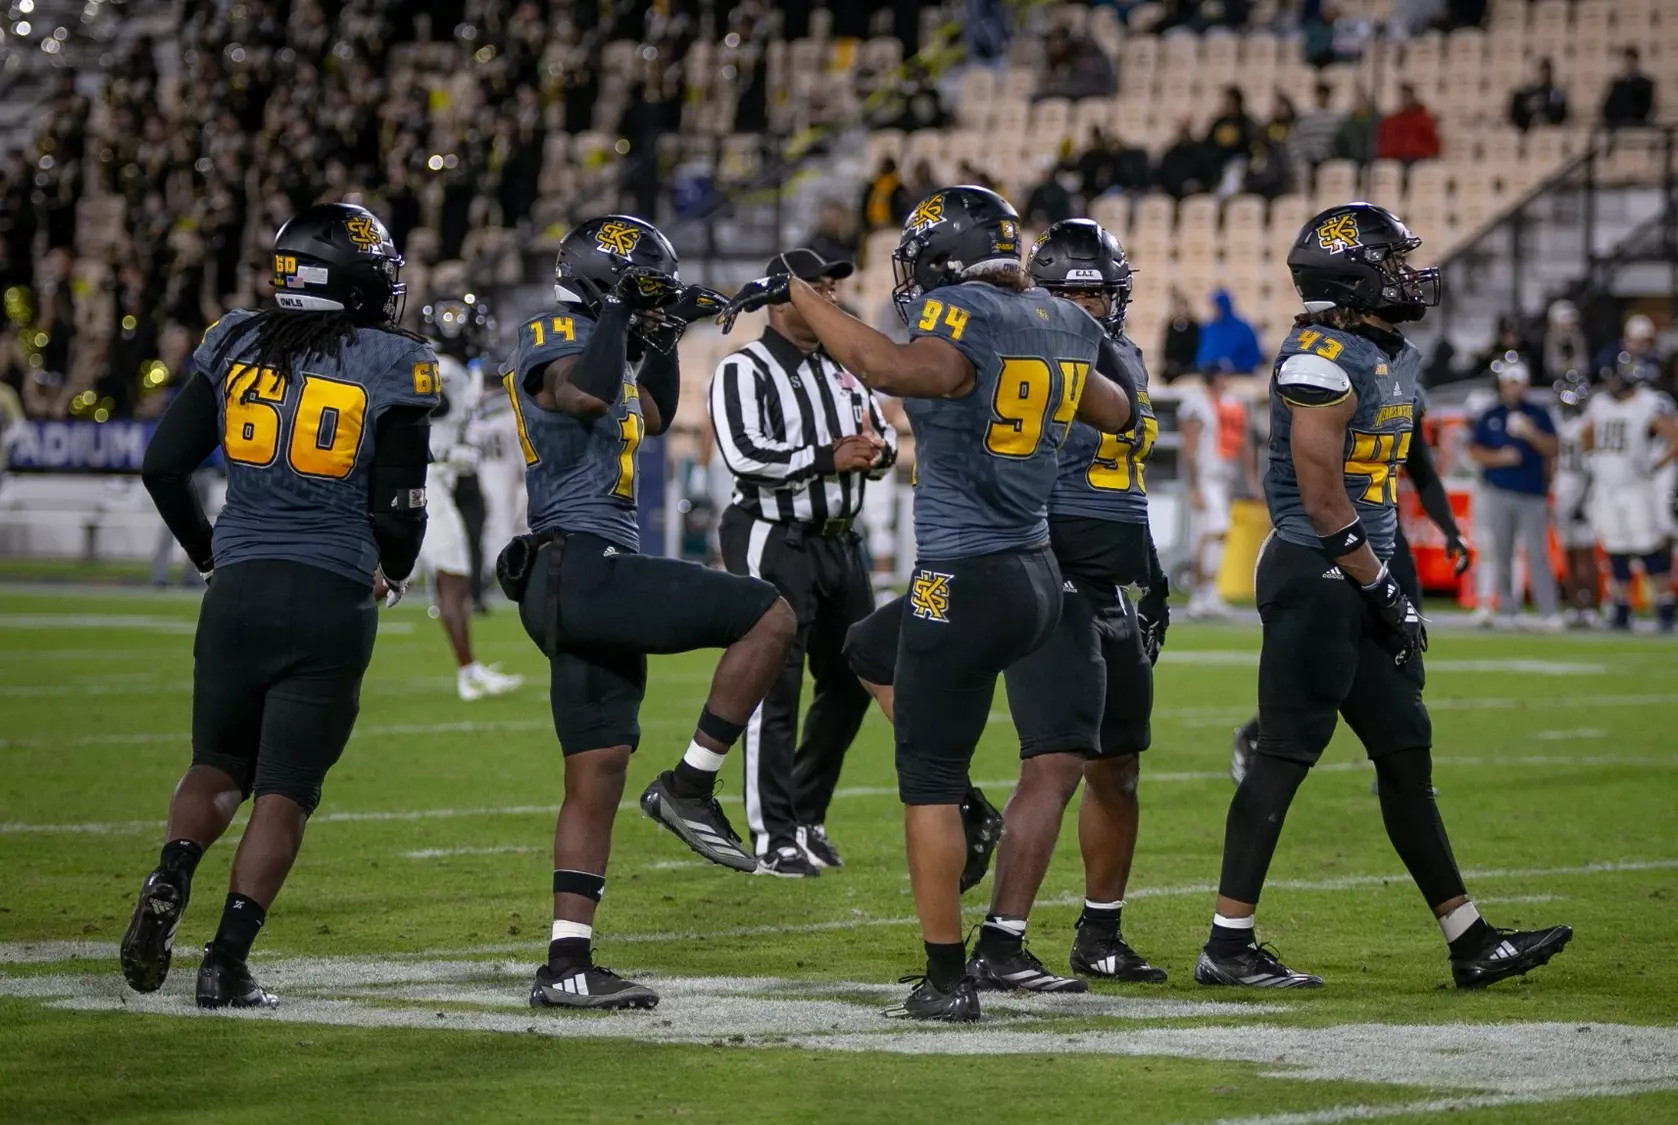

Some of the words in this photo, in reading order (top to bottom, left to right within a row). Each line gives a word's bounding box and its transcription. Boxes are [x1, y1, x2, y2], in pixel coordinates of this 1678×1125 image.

[275, 255, 296, 273] 60
[280, 297, 303, 307] OWLS
[530, 316, 576, 347] 14
[918, 298, 971, 341] 94
[1297, 329, 1345, 361] 43
[790, 375, 801, 388] S
[224, 358, 370, 480] 60
[853, 405, 863, 423] U
[984, 353, 1090, 460] 94
[608, 410, 645, 503] 1
